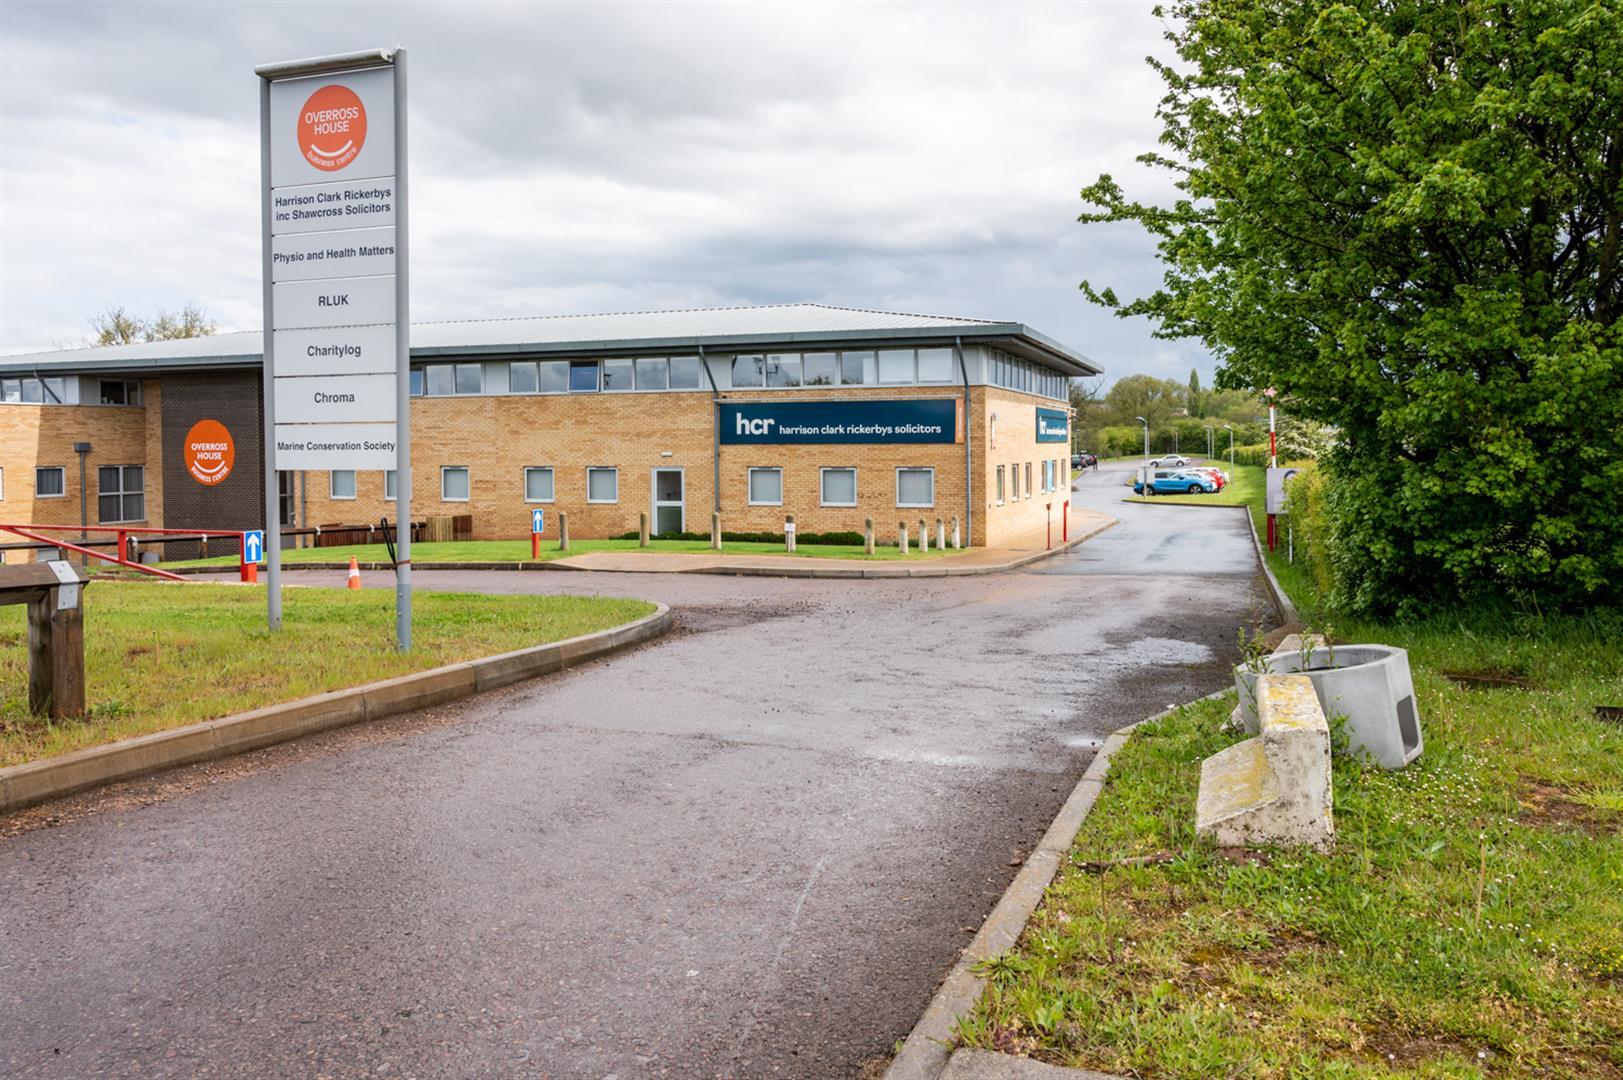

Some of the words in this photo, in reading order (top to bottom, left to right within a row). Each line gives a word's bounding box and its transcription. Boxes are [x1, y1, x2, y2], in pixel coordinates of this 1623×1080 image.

[305, 107, 358, 124] OVERROSS
[314, 120, 349, 135] HOUSE
[275, 195, 315, 207] Harrison
[317, 192, 341, 203] Clark
[344, 188, 391, 200] Rickerbys
[276, 211, 290, 221] inc
[292, 207, 343, 220] Shawcross
[345, 203, 391, 215] Solicitors
[273, 251, 304, 265] Physio
[306, 250, 324, 260] and
[326, 248, 356, 259] Health
[359, 246, 394, 257] Matters
[318, 295, 349, 307] RLUK
[307, 344, 361, 357] Charitylog
[314, 392, 355, 403] Chroma
[736, 412, 775, 436] hcr
[779, 425, 819, 435] harrison
[820, 424, 845, 435] clark
[847, 424, 893, 437] rickerbys
[894, 423, 942, 434] solicitors
[191, 443, 228, 451] OVERROSS
[277, 441, 305, 451] Marine
[306, 441, 361, 451] Conservation
[363, 441, 395, 452] Society
[197, 451, 222, 460] HOUSE
